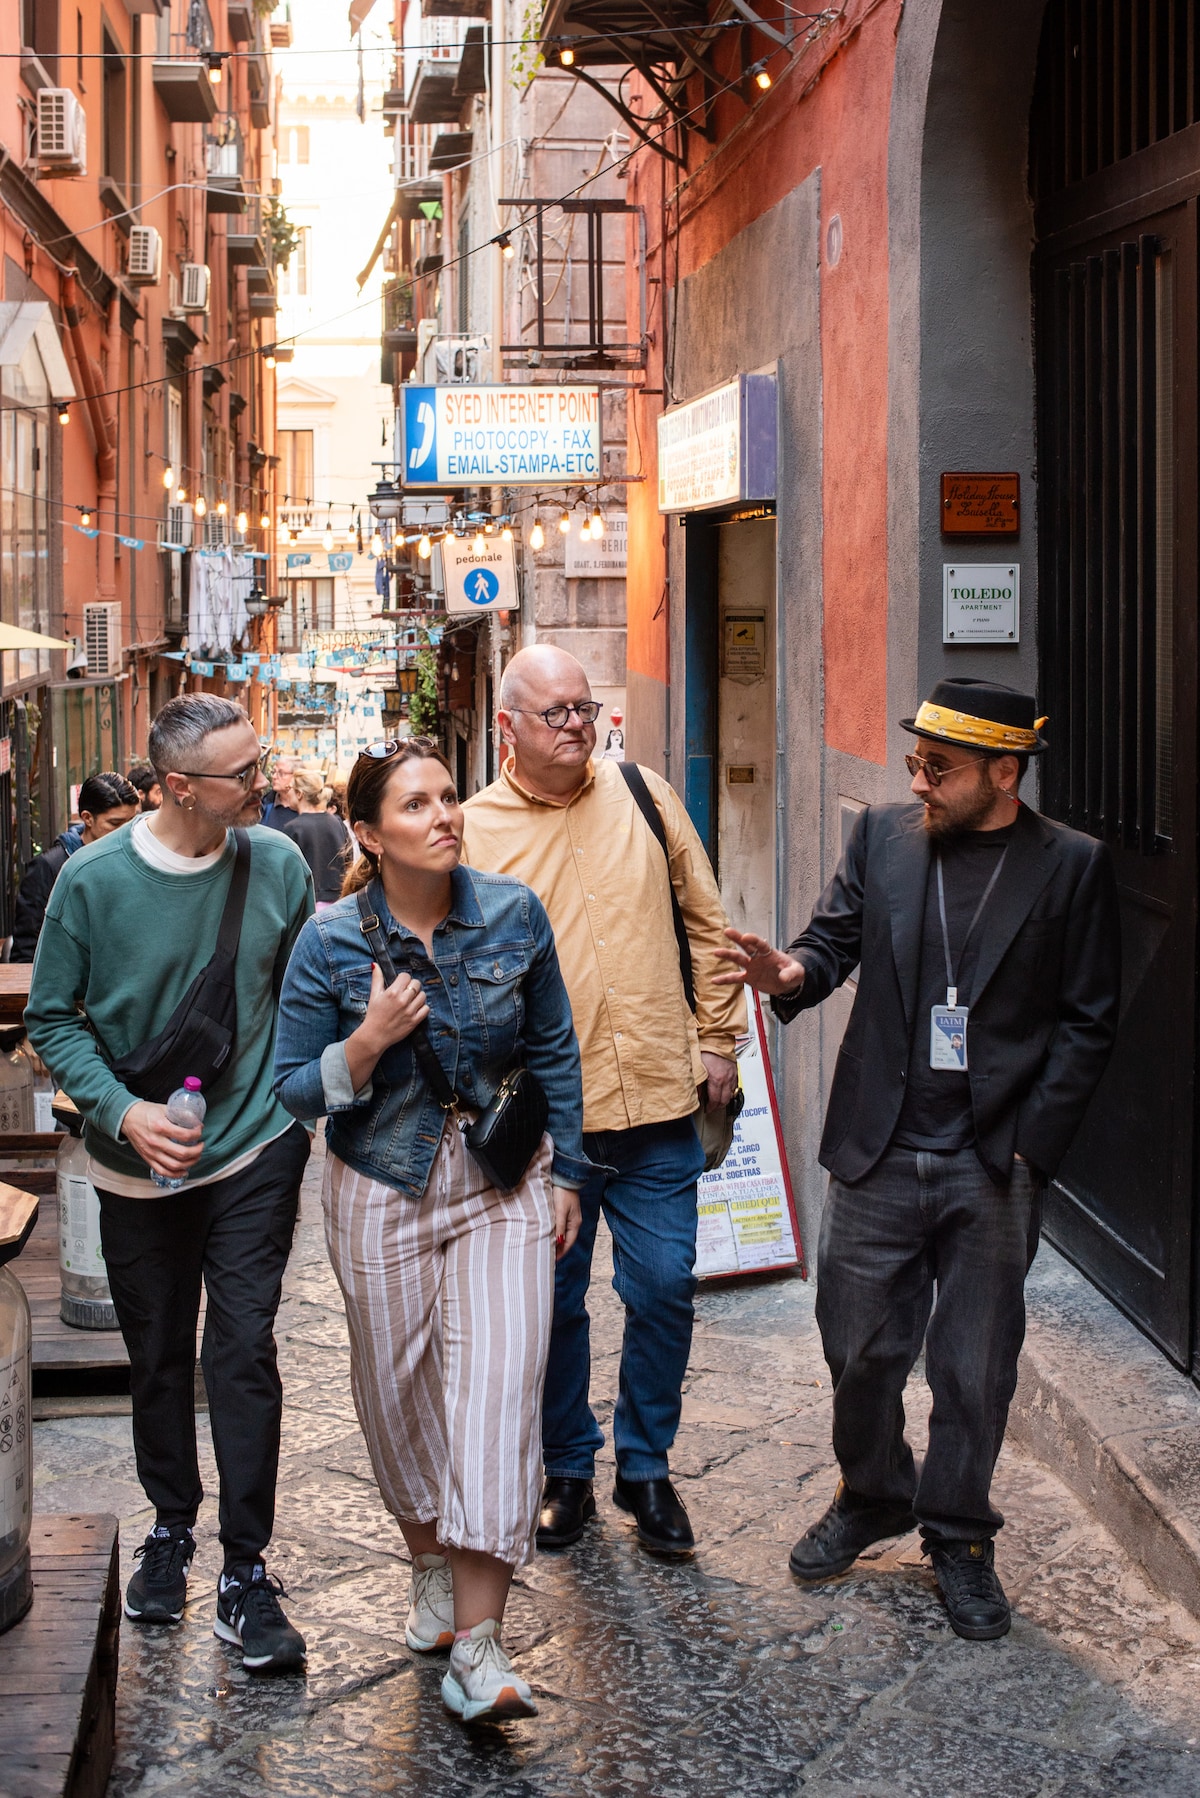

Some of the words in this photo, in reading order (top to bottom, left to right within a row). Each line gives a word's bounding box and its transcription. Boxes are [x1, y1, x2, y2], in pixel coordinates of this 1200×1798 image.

[445, 394, 482, 424] SYED
[487, 393, 554, 424] INTERNET
[559, 392, 599, 423] POINT
[454, 430, 549, 450] PHOTOCOPY
[563, 429, 591, 449] FAX
[448, 453, 599, 475] EMAIL-STAMPA-ETC.
[949, 484, 986, 506] Holiday
[987, 484, 1016, 500] House
[456, 552, 503, 566] pedonale
[950, 587, 1012, 600] TOLEDO
[737, 1143, 760, 1154] CARGO
[725, 1159, 741, 1168] DHL,
[742, 1156, 757, 1166] UPS
[726, 1167, 761, 1179] SOGETRAS
[747, 1180, 761, 1188] CASA
[756, 1184, 780, 1193] LINEA
[730, 1199, 760, 1210] CHIEDI
